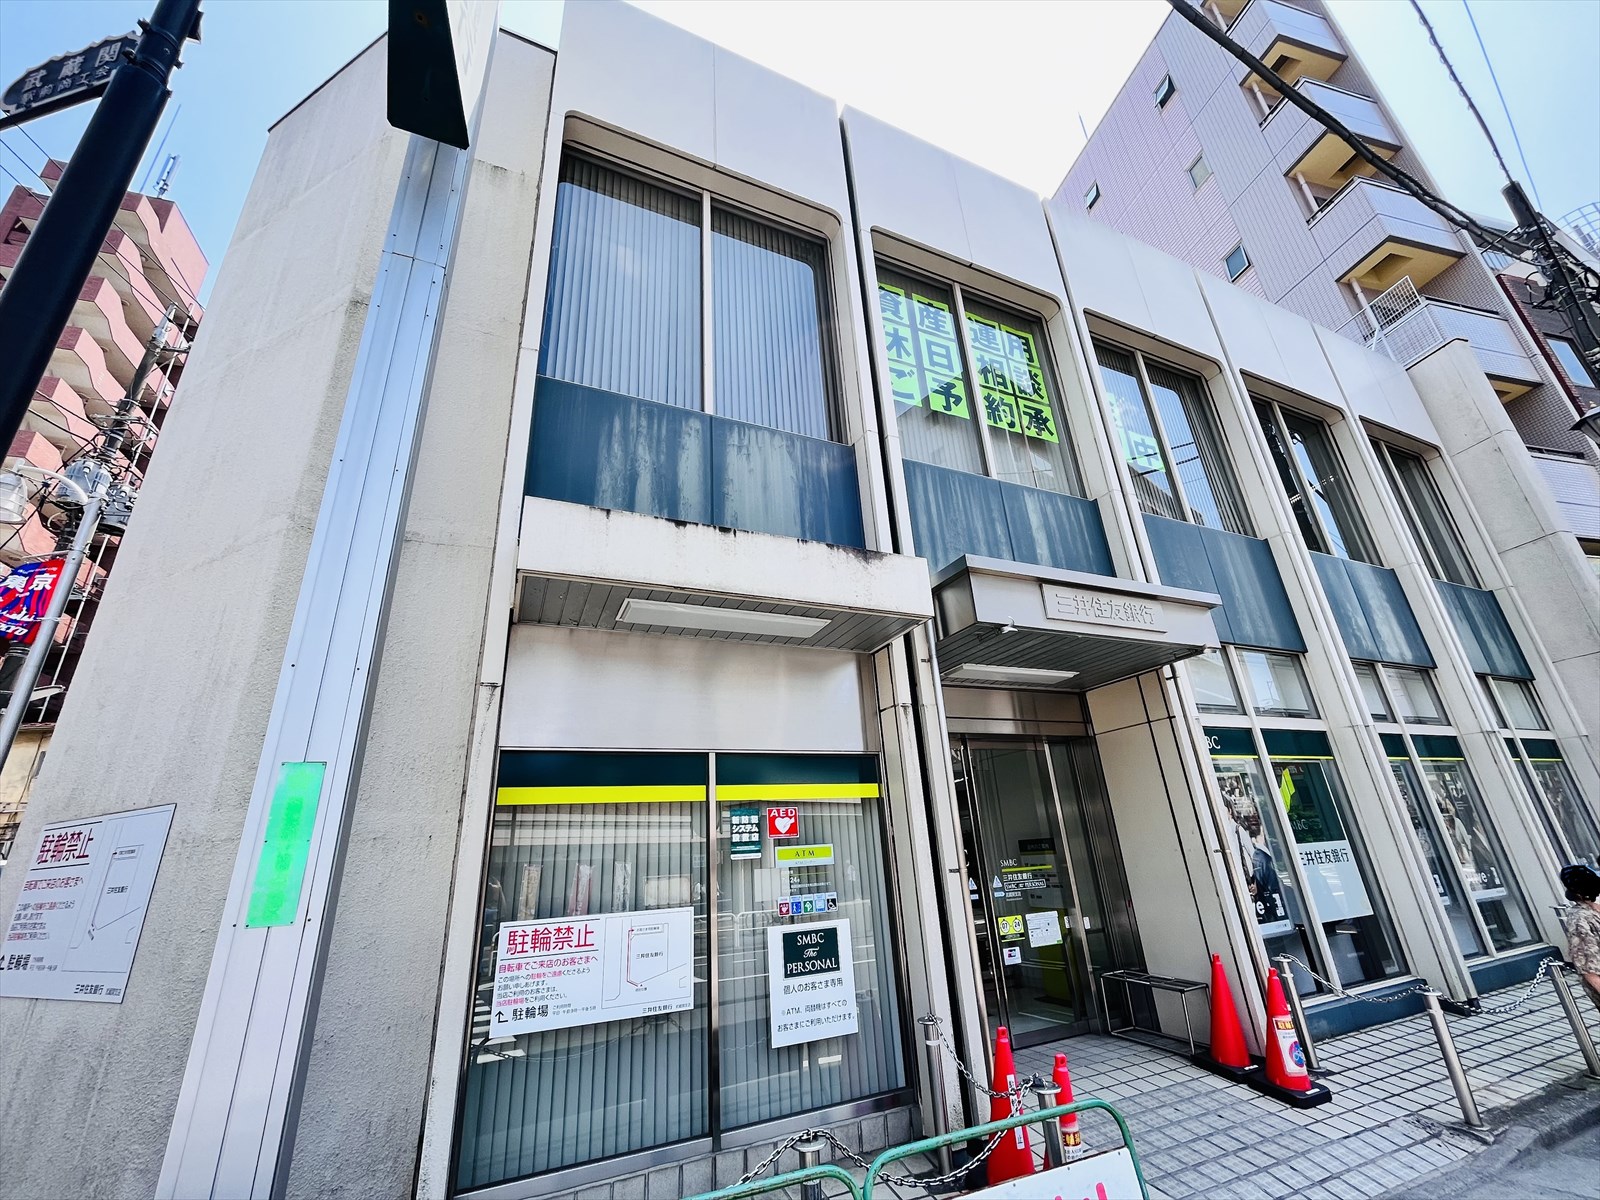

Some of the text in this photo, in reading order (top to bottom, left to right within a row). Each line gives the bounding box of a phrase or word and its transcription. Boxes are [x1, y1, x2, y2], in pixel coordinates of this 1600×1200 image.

[22, 42, 122, 93] 武蔵関
[0, 573, 57, 593] 東京
[1055, 593, 1155, 625] 三井住友銀行
[769, 808, 796, 818] AED
[731, 824, 759, 834] システム
[36, 828, 94, 865] 駐輪禁止
[1000, 858, 1017, 867] SMBC
[1001, 920, 1021, 931] 07 24
[506, 923, 595, 956] 駐輪禁止
[797, 932, 825, 945] SMBC
[803, 947, 820, 958] The
[498, 955, 599, 974] 自転車でご来店のお客さまへ
[787, 957, 838, 975] PERSONAL
[783, 977, 844, 996] 個人のお客さま専用
[512, 1004, 549, 1022] 駐輪場
[642, 1003, 673, 1014] 三井住友銀行
